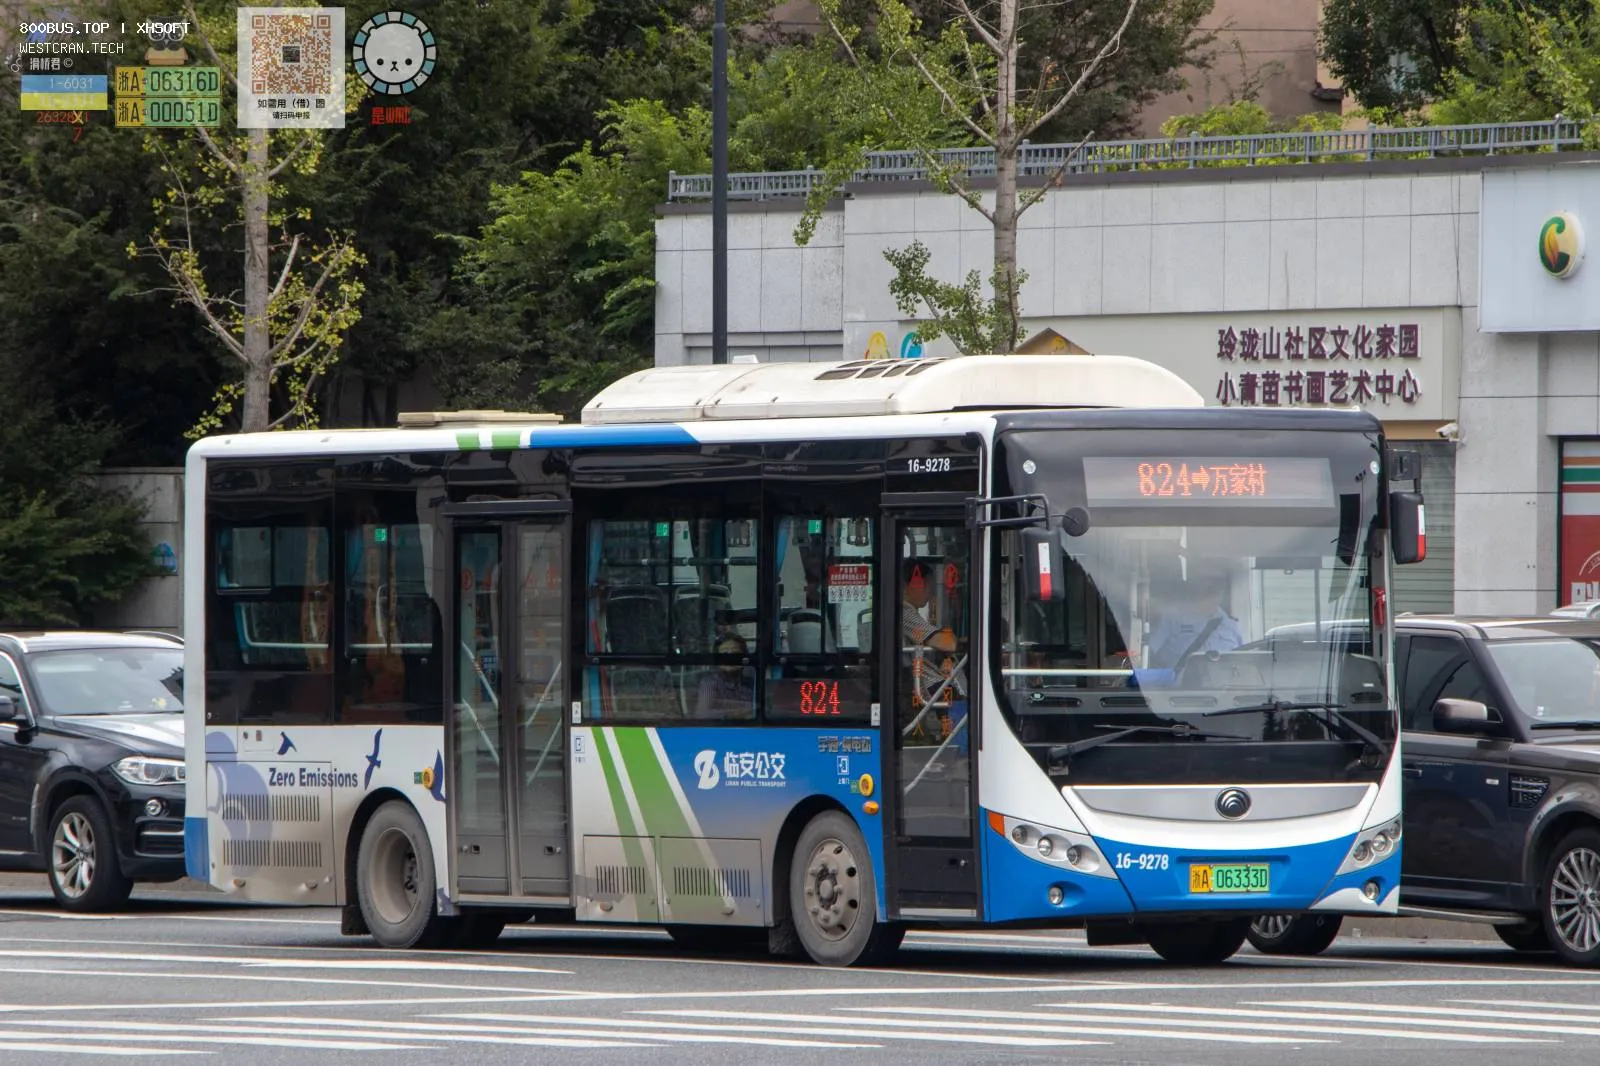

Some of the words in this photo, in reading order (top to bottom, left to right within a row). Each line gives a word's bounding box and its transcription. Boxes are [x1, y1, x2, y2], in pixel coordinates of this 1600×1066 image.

[1217, 324, 1420, 361] 玲珑山社区文化家园
[1216, 368, 1422, 406] 小青苗书画艺术中心
[907, 457, 950, 473] 16-9278
[1137, 463, 1191, 496] 824
[1209, 463, 1267, 496] 万家村
[800, 681, 841, 714] 824
[269, 767, 296, 787] Zero
[299, 767, 358, 788] Emissions
[724, 752, 786, 779] 临安公交
[1115, 852, 1169, 870] 16-9278
[1216, 869, 1268, 889] 06333D
